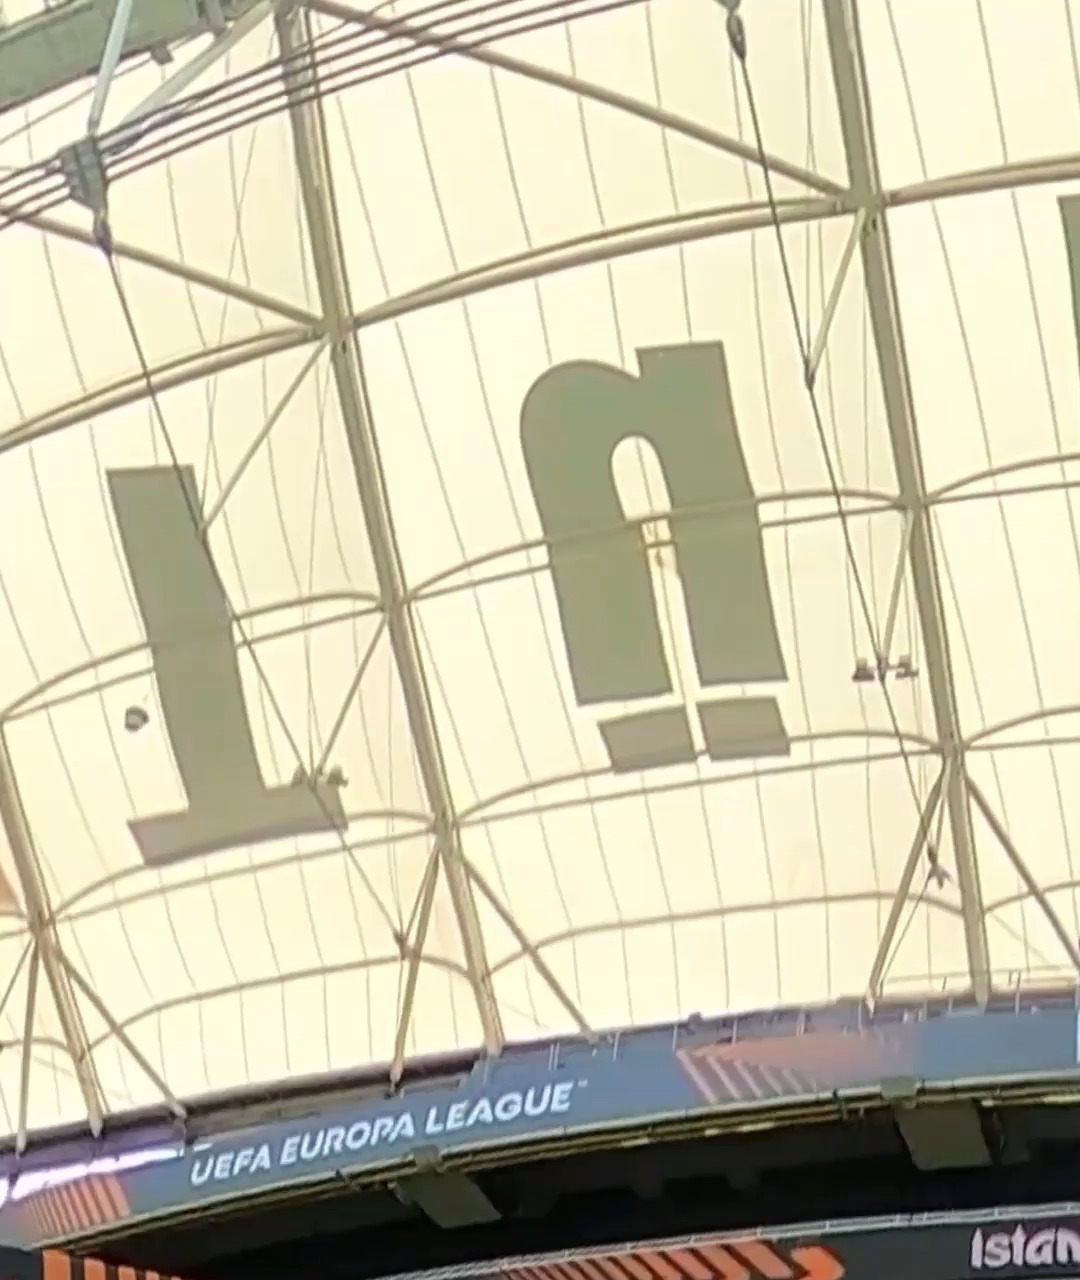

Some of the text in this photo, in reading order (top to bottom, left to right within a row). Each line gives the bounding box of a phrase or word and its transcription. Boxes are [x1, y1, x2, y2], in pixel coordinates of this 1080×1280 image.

[190, 1080, 574, 1186] UEFA EUROPA LEAGUE
